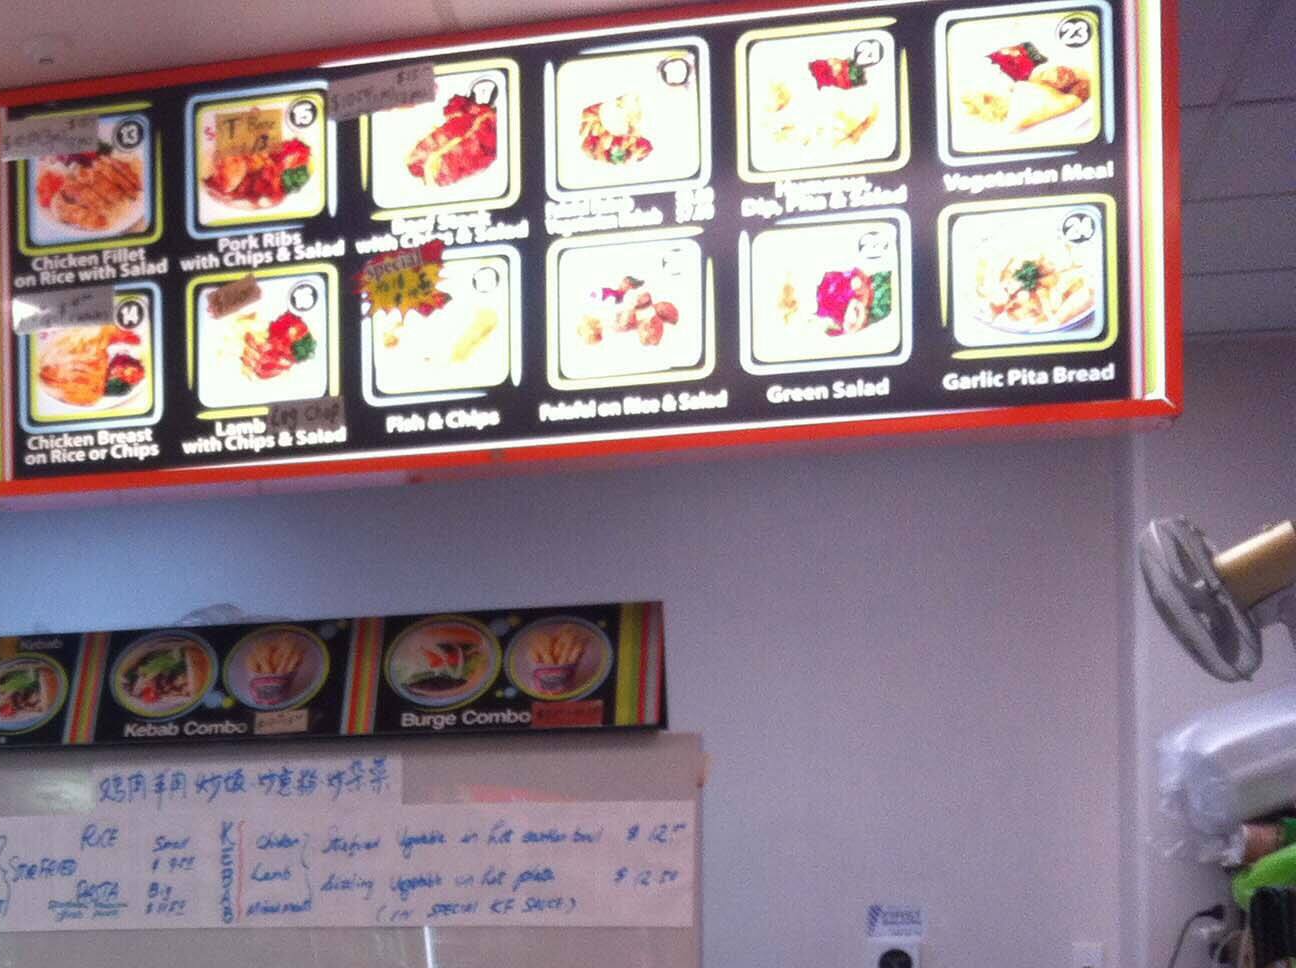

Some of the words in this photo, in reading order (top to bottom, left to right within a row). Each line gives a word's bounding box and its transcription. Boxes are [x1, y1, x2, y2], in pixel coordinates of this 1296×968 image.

[943, 167, 1058, 193] Vegetarian
[1061, 160, 1114, 183] Meal
[218, 236, 260, 252] Pork
[262, 231, 302, 247] Ribs
[31, 252, 99, 272] Chicken
[103, 248, 146, 264] Fillet
[180, 252, 220, 271] with
[223, 249, 273, 268] Chips
[294, 239, 345, 260] Salad
[14, 275, 37, 288] on
[40, 269, 75, 285] Rice
[79, 264, 116, 281] with
[120, 258, 169, 278] Salad
[942, 370, 1004, 391] Garlic
[1007, 367, 1049, 386] Pita
[1053, 363, 1115, 383] Bread
[767, 381, 828, 403] Green
[832, 377, 889, 399] Salad
[27, 434, 94, 450] Chicken
[97, 428, 153, 446] Breast
[182, 436, 222, 454] with
[225, 434, 275, 452] Chips
[296, 425, 347, 445] Salad
[215, 418, 266, 437] Lamb
[25, 452, 47, 465] on
[51, 446, 85, 463] Rice
[89, 448, 108, 460] or
[110, 442, 159, 460] Chips
[124, 721, 179, 738] Kebab
[183, 719, 248, 736] Combo
[400, 711, 456, 730] Burge
[462, 708, 532, 726] Combo
